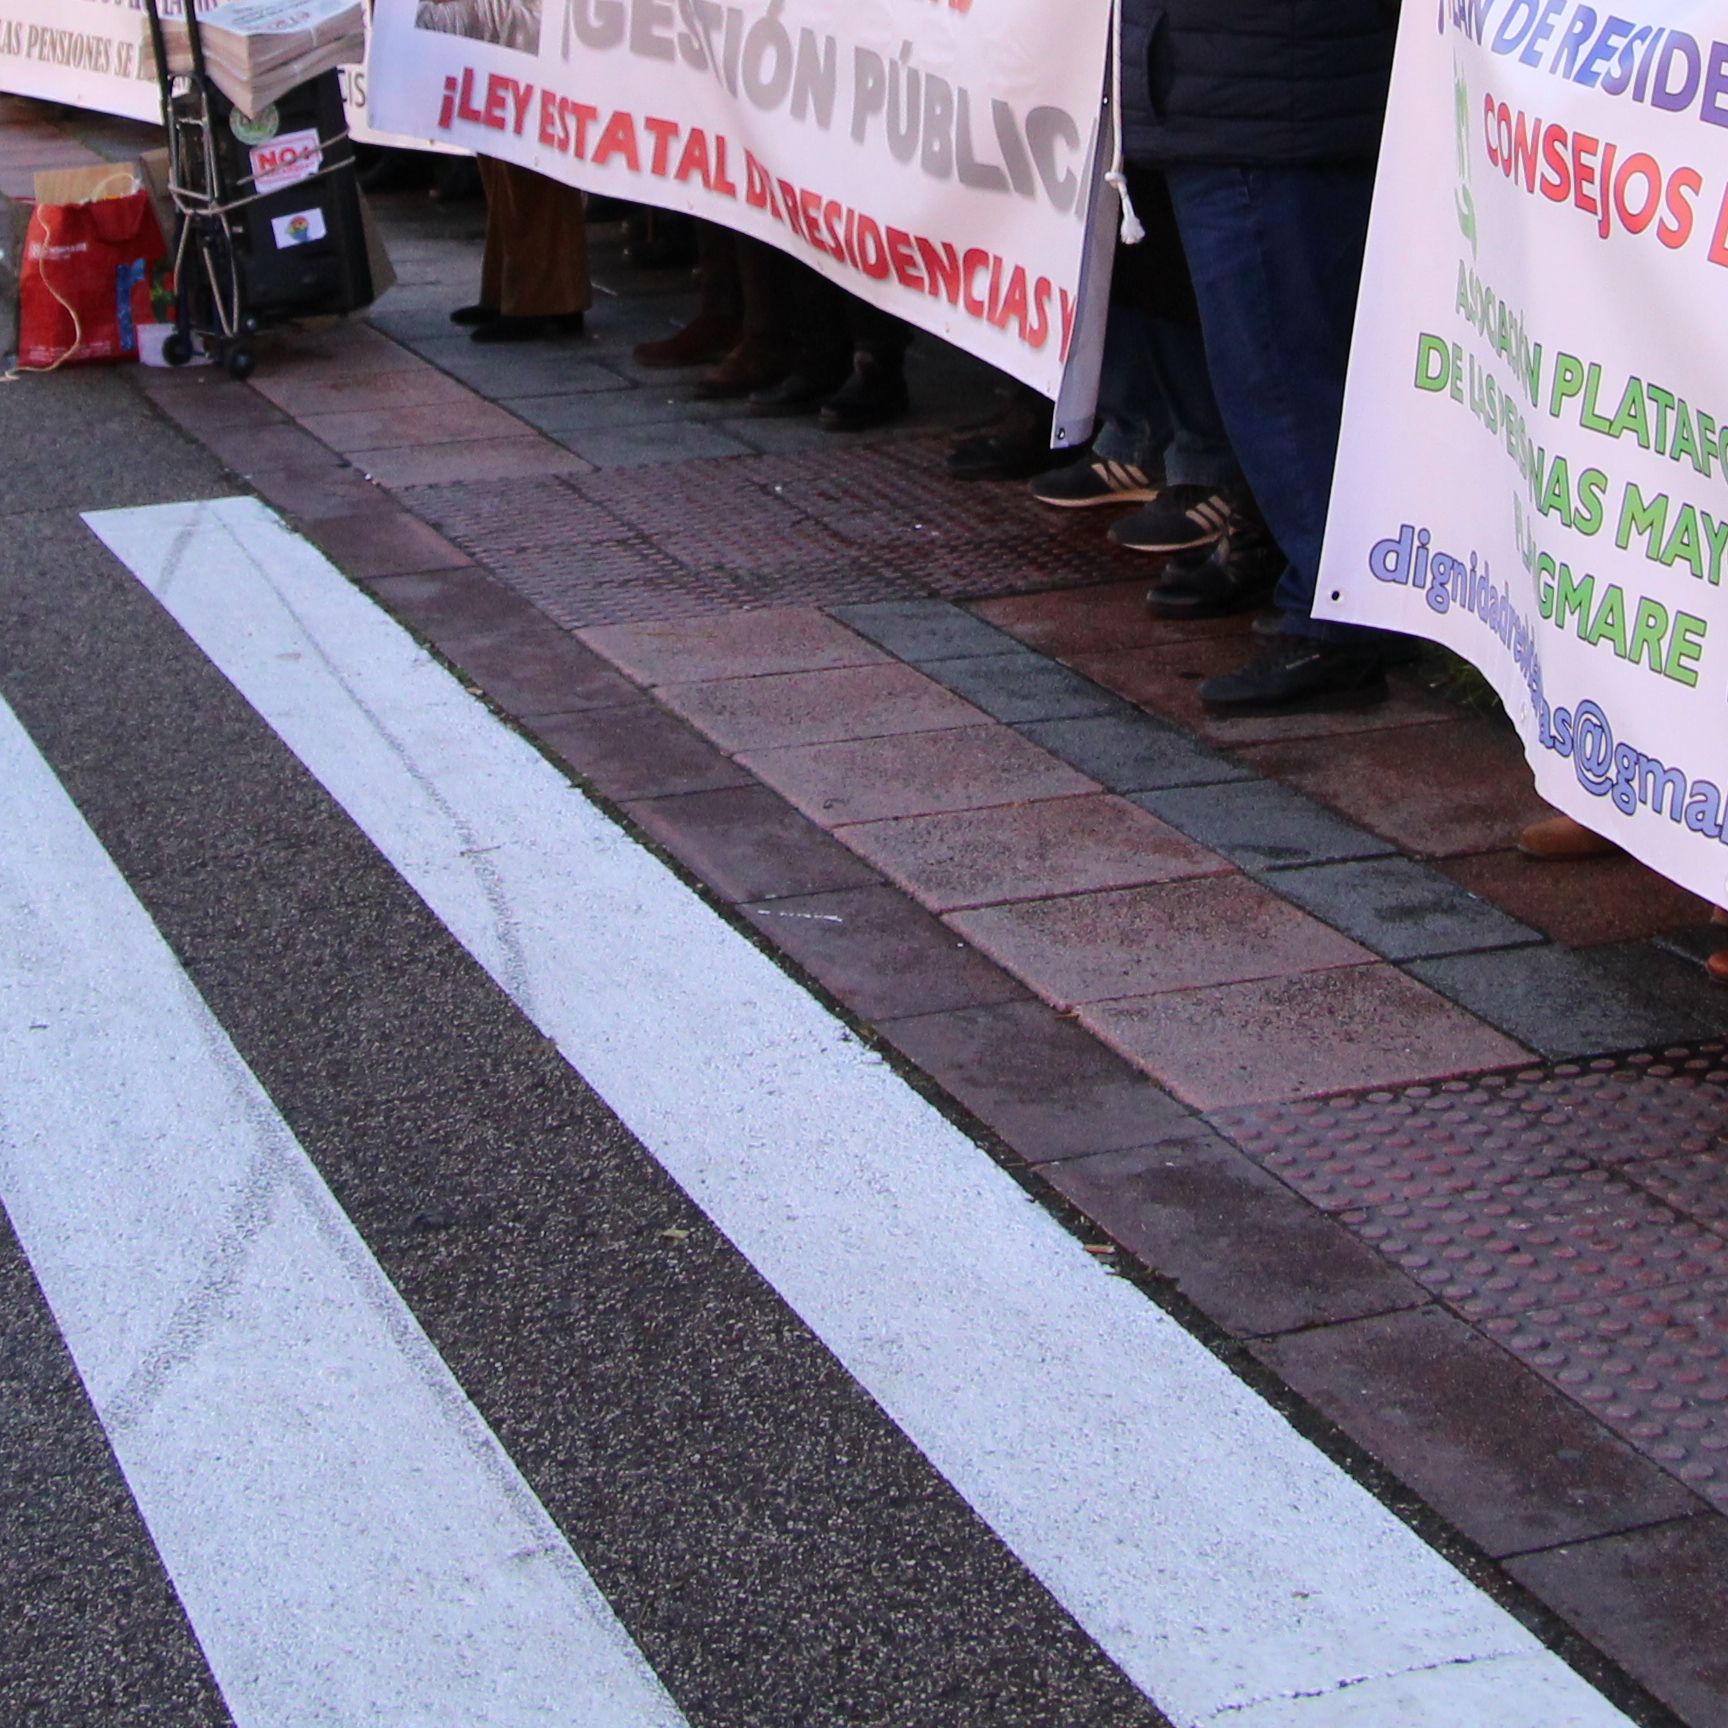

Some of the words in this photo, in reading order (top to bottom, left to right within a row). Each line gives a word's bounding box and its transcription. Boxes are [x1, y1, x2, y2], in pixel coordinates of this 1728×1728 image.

[26, 23, 111, 74] PENSIONES
[114, 41, 133, 81] SE
[437, 67, 534, 137] ¡LEY
[540, 92, 736, 200] ESTATAL
[777, 177, 1052, 349] RESIDENCIAS
[1483, 92, 1704, 251] CONSEJOS
[1414, 331, 1465, 406] DE
[1469, 353, 1498, 435] LAS
[1498, 382, 1609, 537] PERNAS
